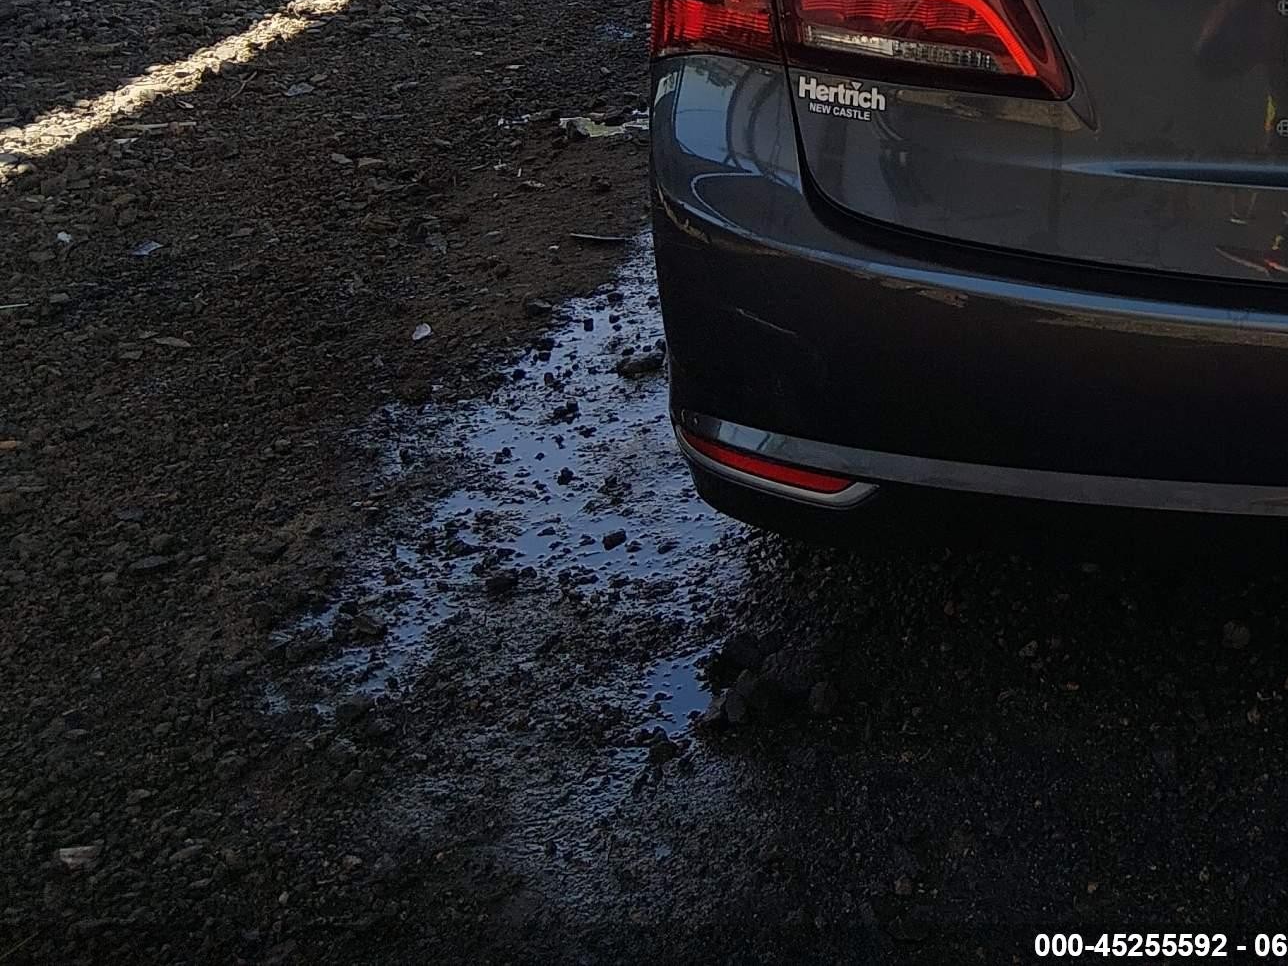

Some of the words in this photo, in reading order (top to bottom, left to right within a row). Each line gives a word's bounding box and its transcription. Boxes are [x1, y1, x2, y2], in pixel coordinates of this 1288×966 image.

[799, 76, 886, 110] Hertrich
[809, 102, 832, 115] NEW
[833, 107, 871, 121] CASTLE
